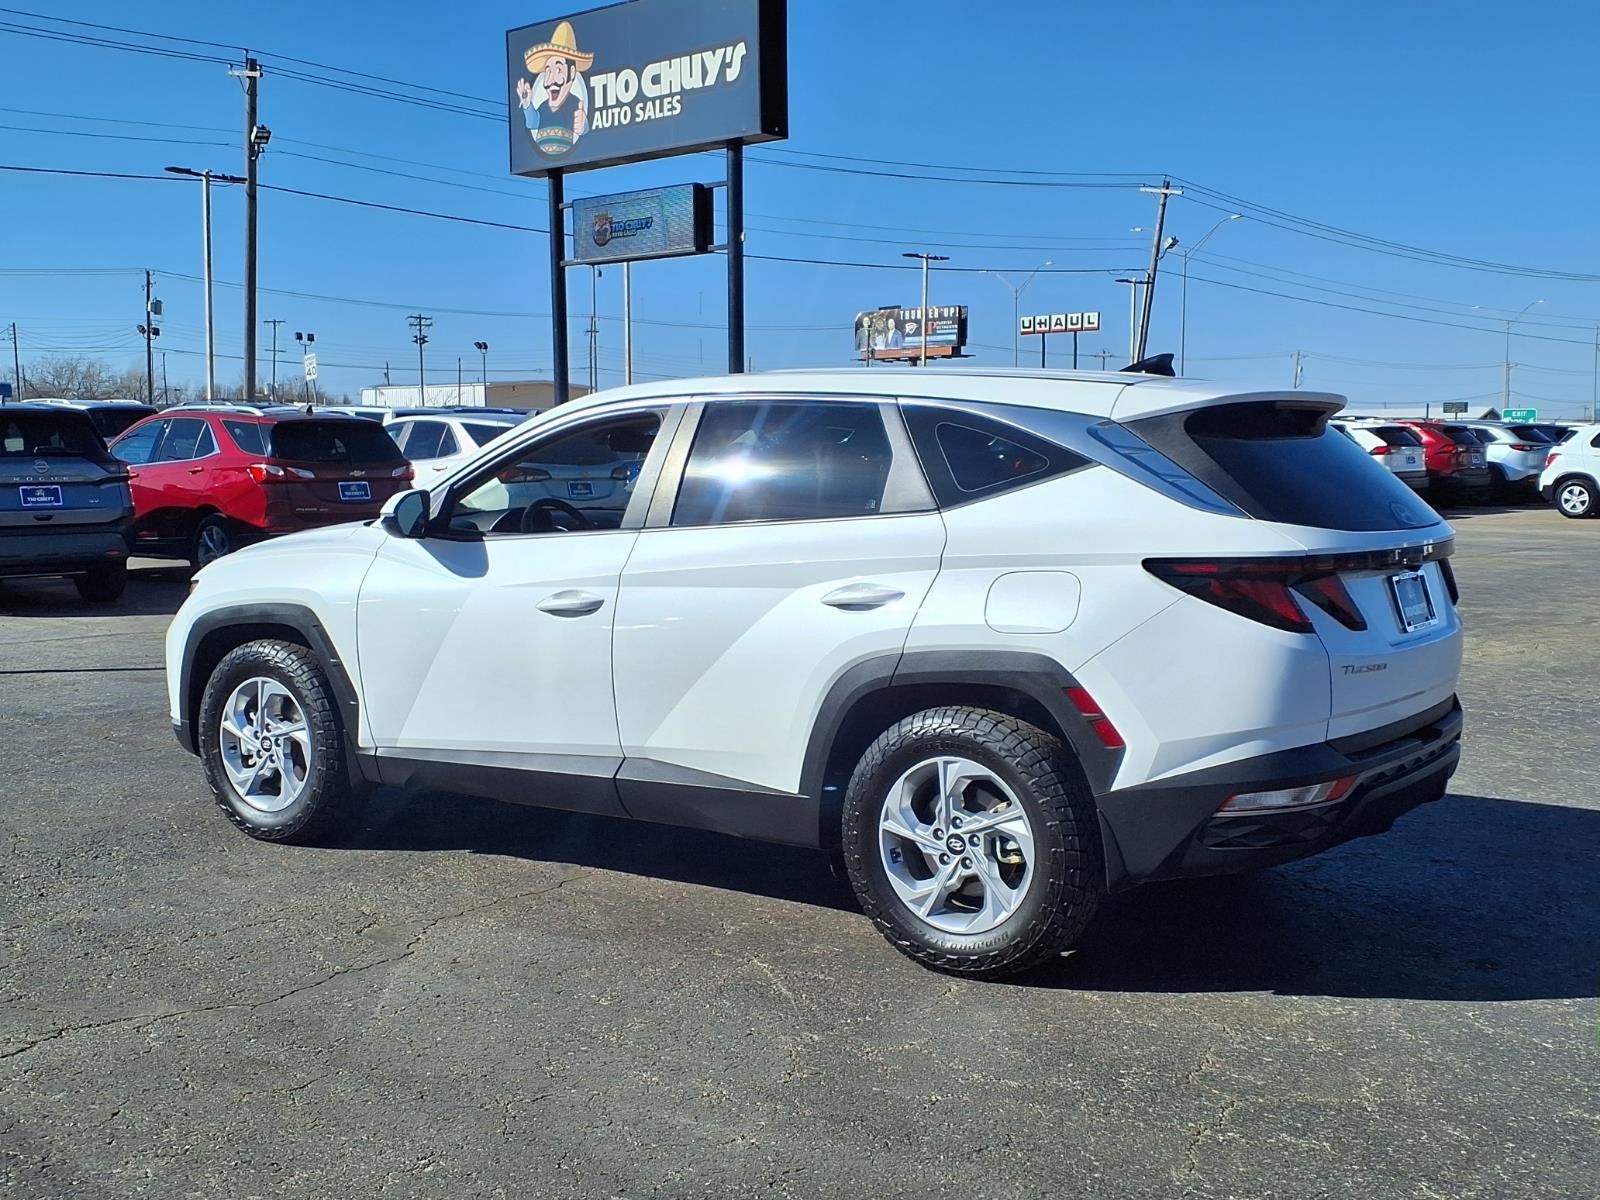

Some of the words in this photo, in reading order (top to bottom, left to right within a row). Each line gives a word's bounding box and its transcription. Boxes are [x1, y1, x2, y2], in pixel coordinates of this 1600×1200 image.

[590, 69, 638, 109] TIO
[641, 42, 746, 98] CHUY'S
[592, 106, 631, 130] AUTO
[635, 95, 682, 123] SALES
[900, 307, 939, 320] THUNER
[306, 366, 316, 376] 40
